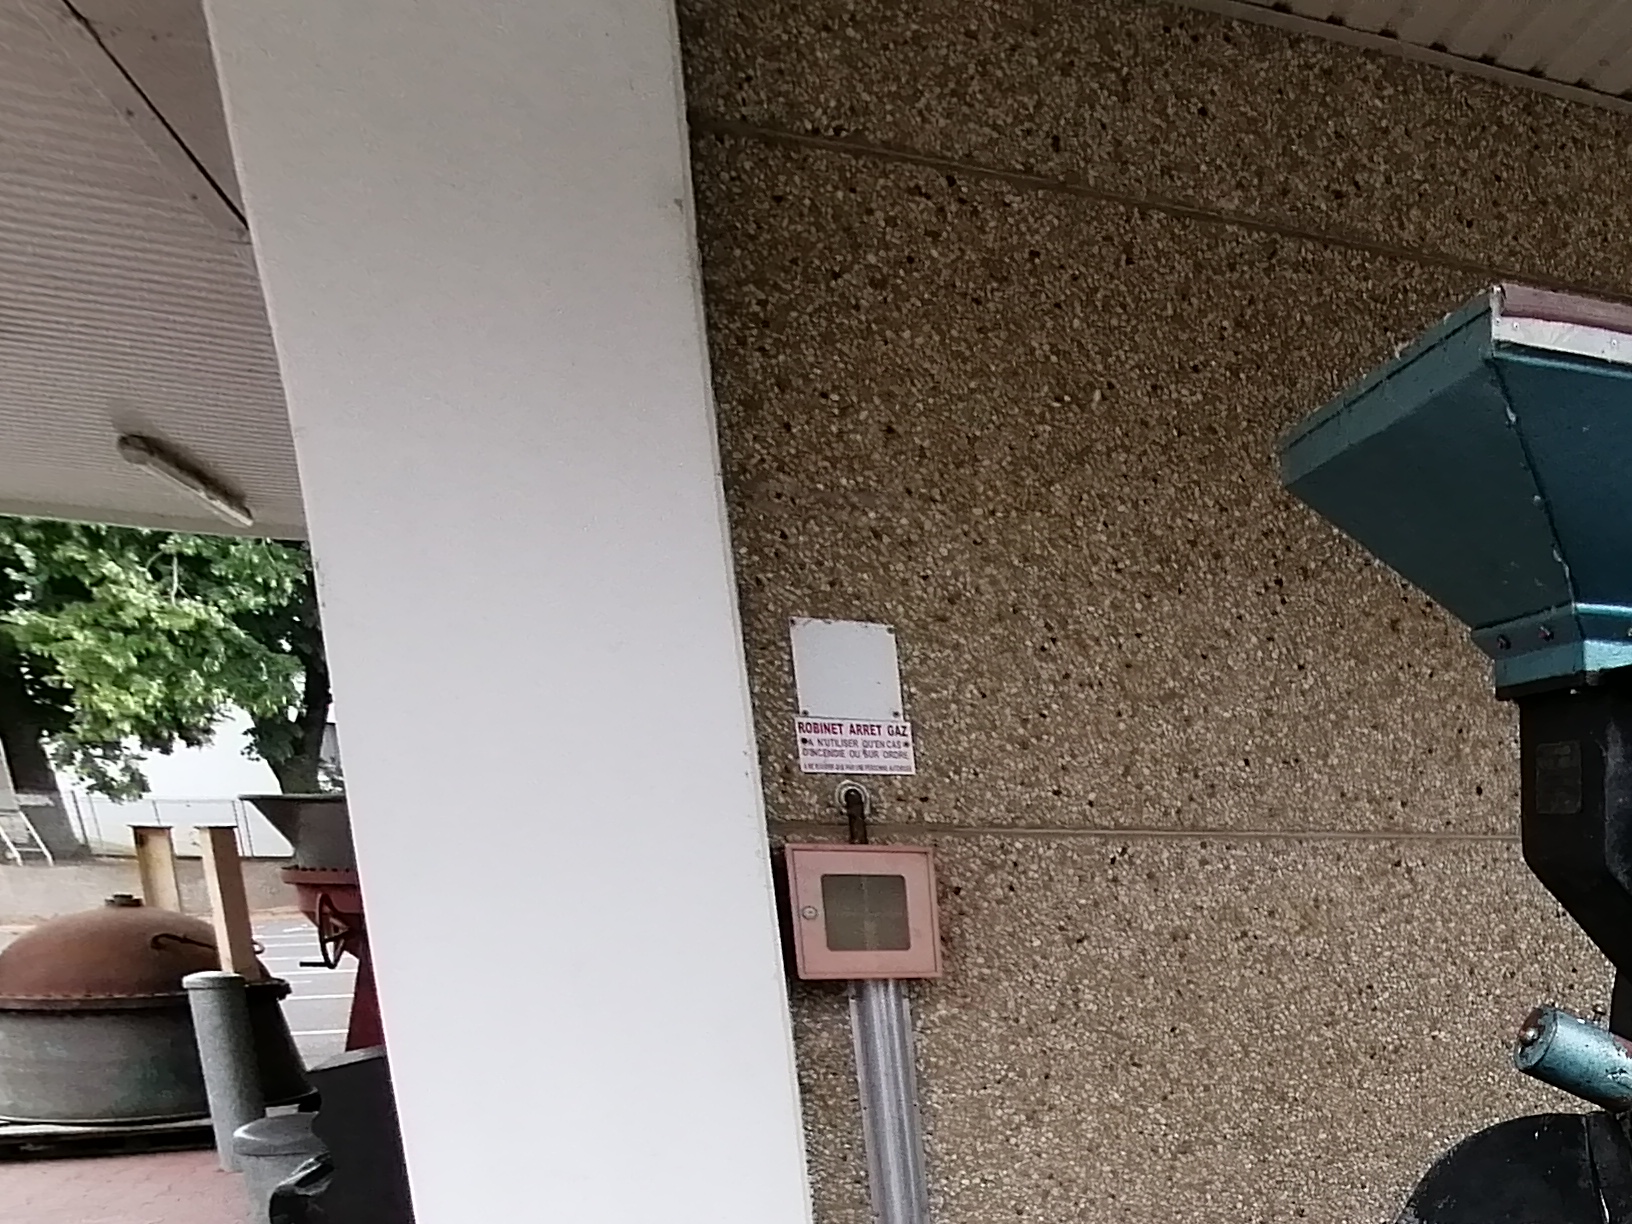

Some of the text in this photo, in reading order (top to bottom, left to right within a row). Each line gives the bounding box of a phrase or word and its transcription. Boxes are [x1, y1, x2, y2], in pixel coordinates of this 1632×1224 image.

[797, 722, 908, 737] ROBINET ARRET GAZ
[886, 740, 901, 749] CAS
